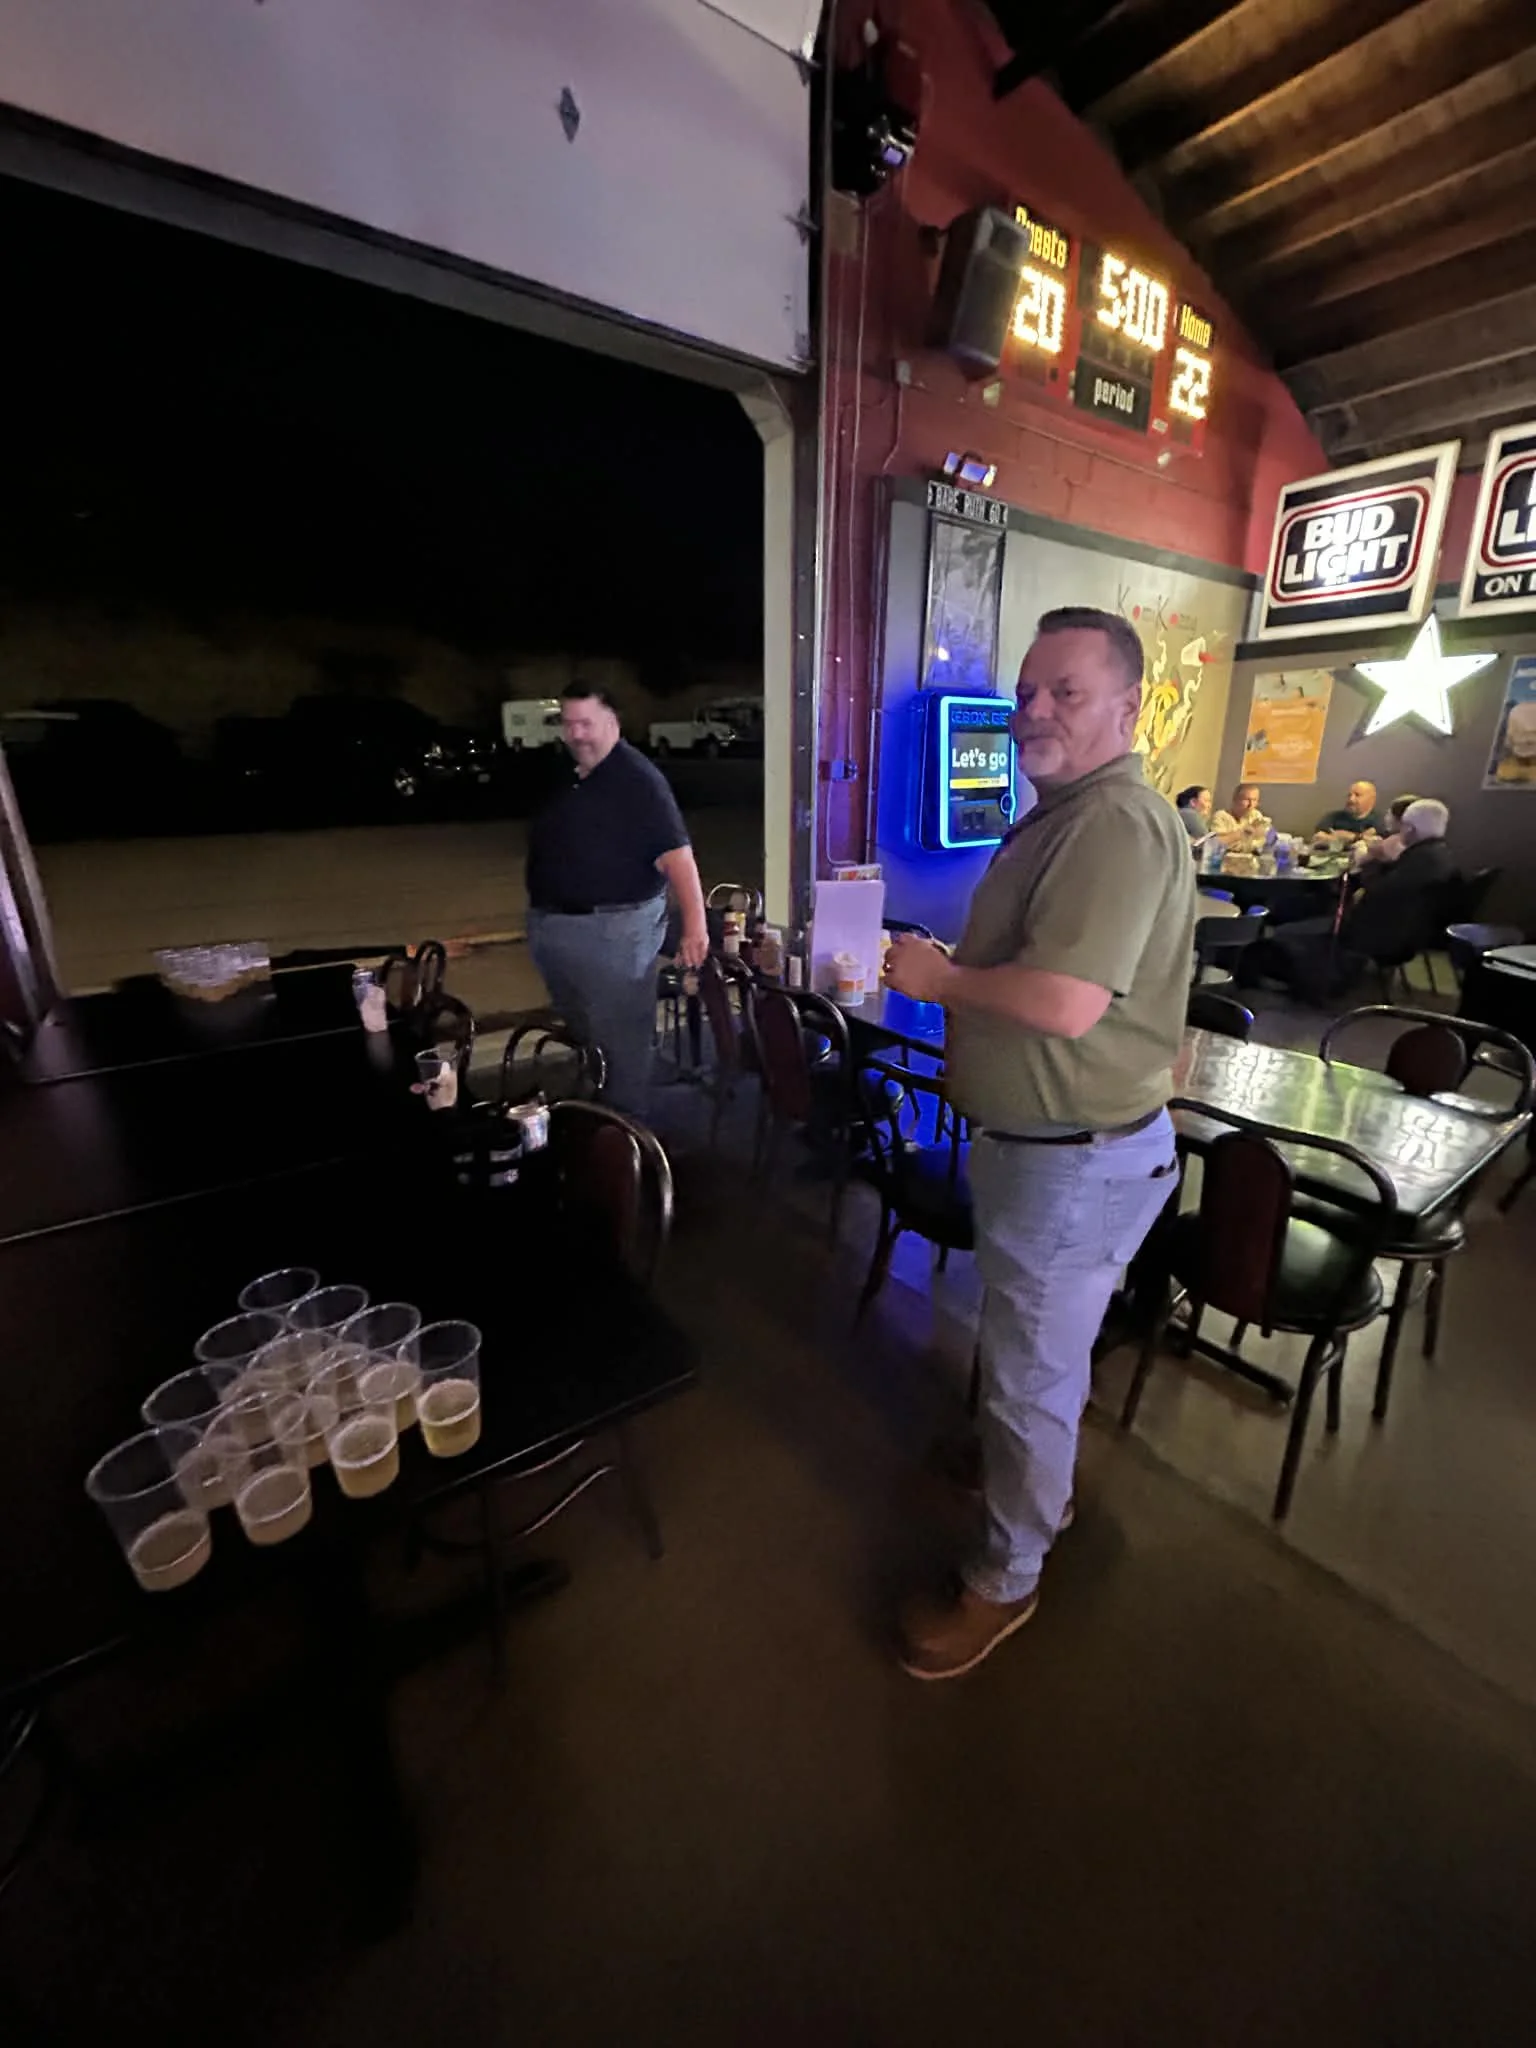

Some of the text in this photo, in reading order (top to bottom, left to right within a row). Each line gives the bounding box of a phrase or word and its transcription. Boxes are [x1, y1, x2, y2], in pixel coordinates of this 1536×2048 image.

[1013, 266, 1065, 352] 20
[1097, 254, 1168, 351] 5:00
[1180, 304, 1210, 348] Home
[1094, 378, 1134, 414] period
[1169, 347, 1211, 419] 22
[1303, 505, 1395, 550] BUD
[1283, 534, 1408, 586] LIGHT
[1485, 574, 1522, 596] ON
[952, 748, 1007, 771] Let's go
